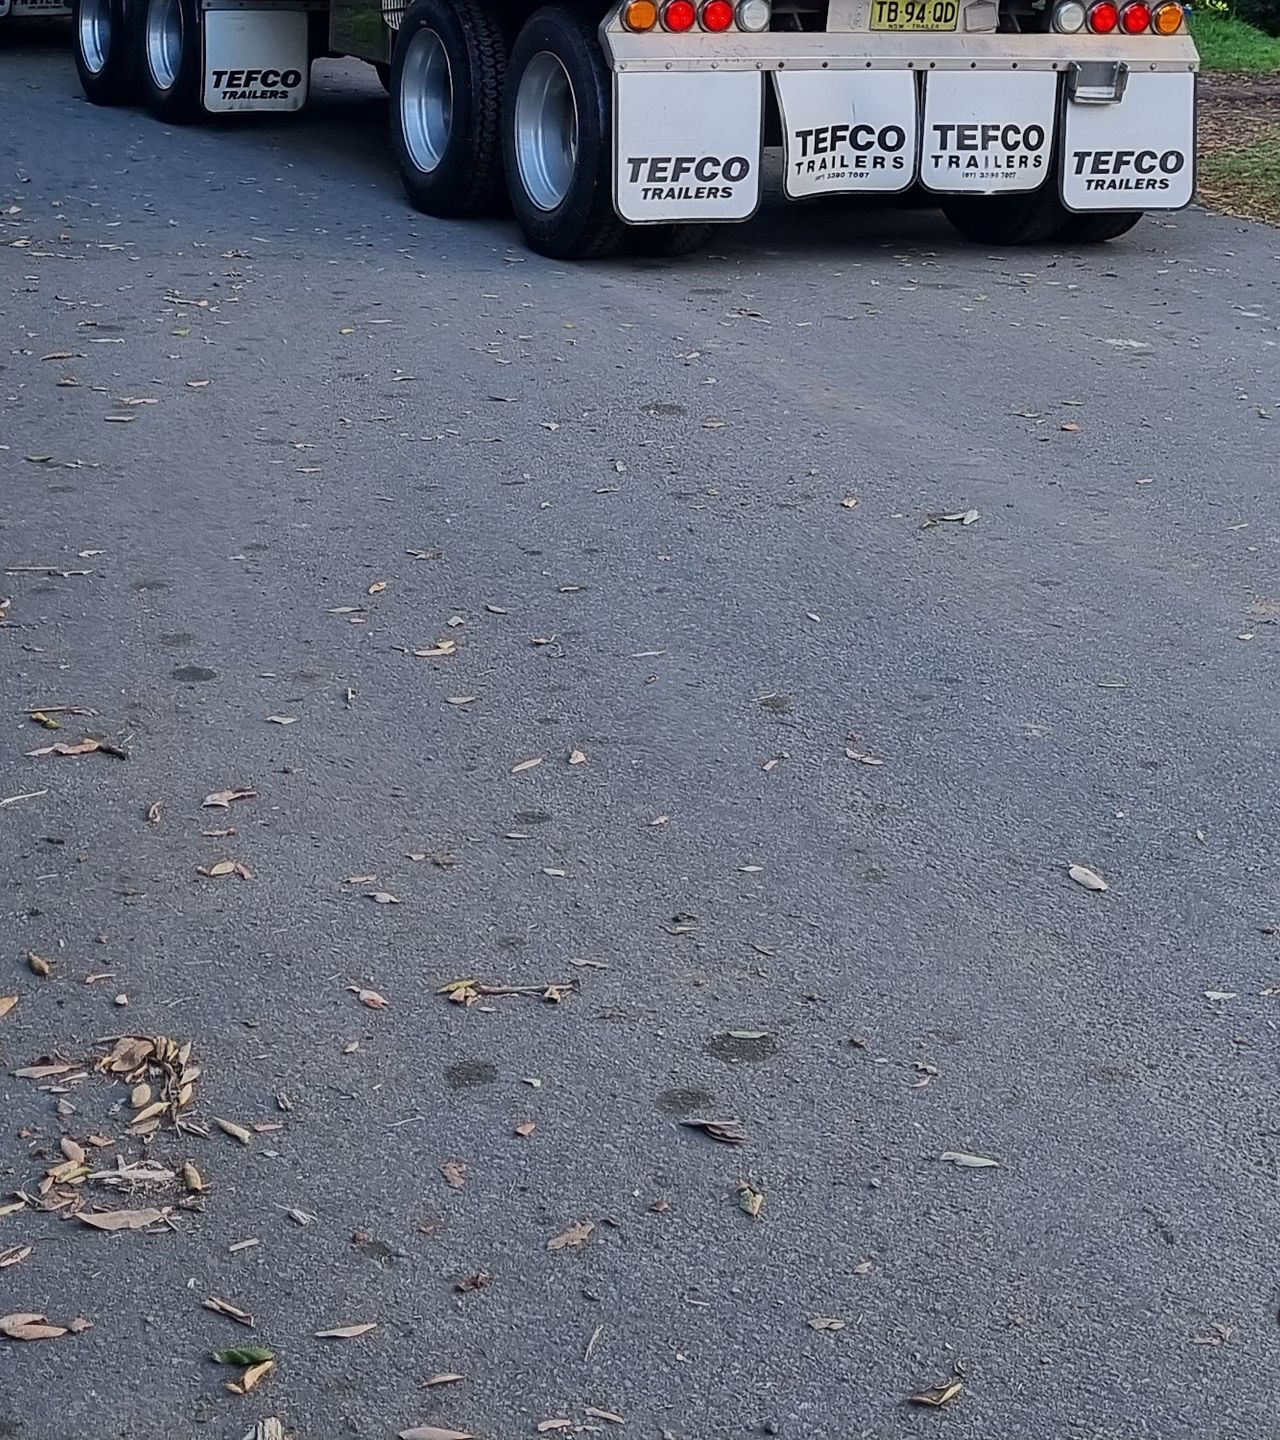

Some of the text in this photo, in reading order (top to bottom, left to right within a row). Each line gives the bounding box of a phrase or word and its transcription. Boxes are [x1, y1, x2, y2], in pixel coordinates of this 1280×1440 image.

[212, 69, 302, 89] TEFCO
[222, 89, 289, 100] TRAILERS
[795, 124, 906, 157] TEFCO
[933, 124, 1045, 152] TEFCO
[627, 156, 750, 183] TEFCO
[795, 155, 904, 176] TRAILERS
[931, 154, 1043, 169] TRAILERS
[1073, 150, 1185, 175] TEFCO
[640, 186, 734, 200] TRAILERS
[1085, 178, 1170, 191] TRAILERS
